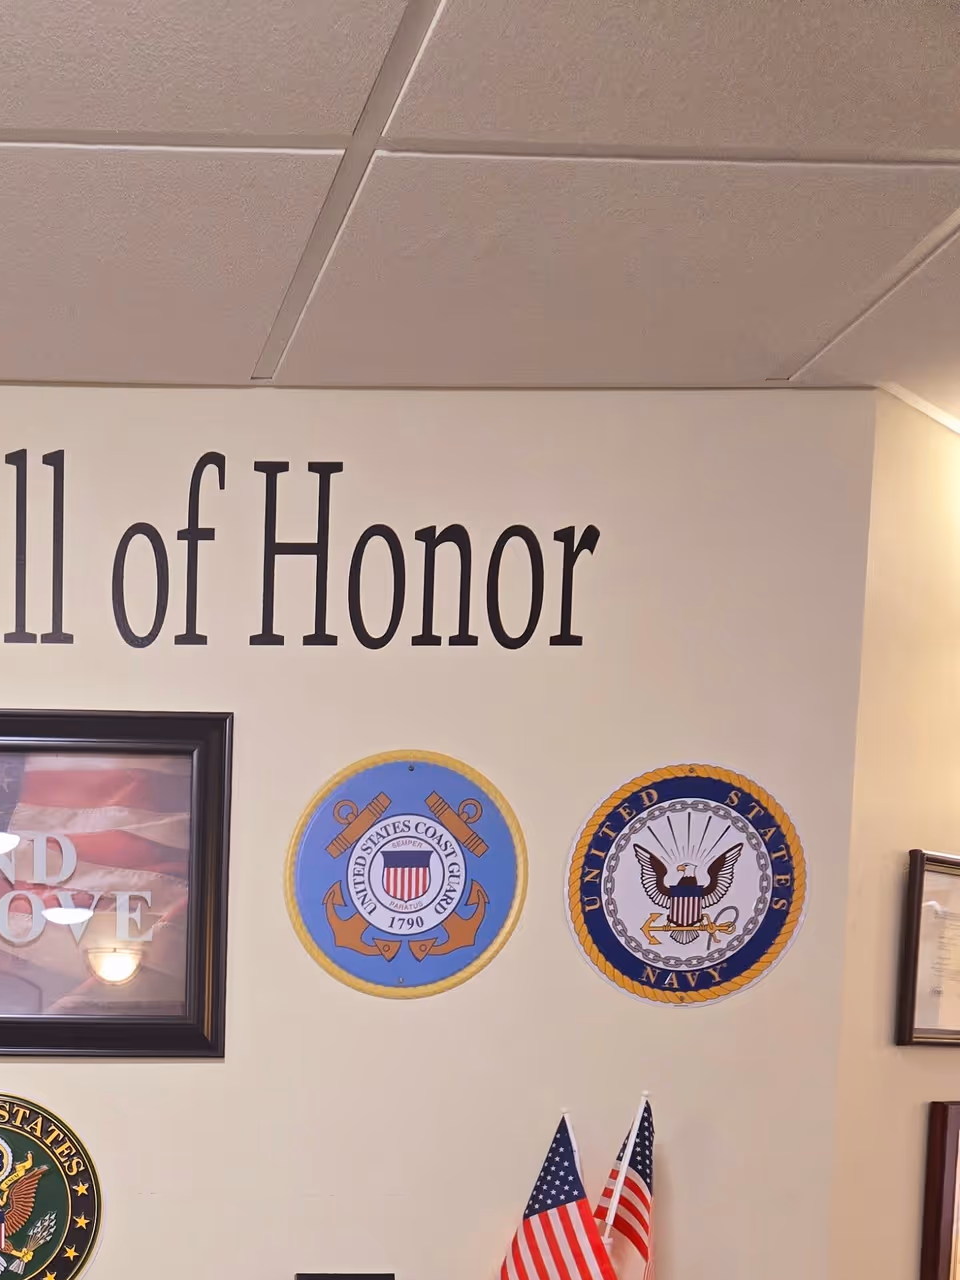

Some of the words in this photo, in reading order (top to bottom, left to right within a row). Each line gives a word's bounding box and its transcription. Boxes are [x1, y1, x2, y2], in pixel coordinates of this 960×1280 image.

[111, 451, 227, 649] of
[248, 461, 601, 650] Honor
[361, 819, 411, 856] STATES
[391, 840, 424, 849] SEMPER
[414, 820, 458, 859] COAST
[583, 788, 659, 912] UNITED
[724, 790, 791, 911] STATES
[352, 855, 378, 916] UNITED
[433, 862, 462, 915] GUARD
[387, 915, 425, 931] 1790
[388, 901, 424, 911] PARATUS
[639, 965, 722, 989] NAVY
